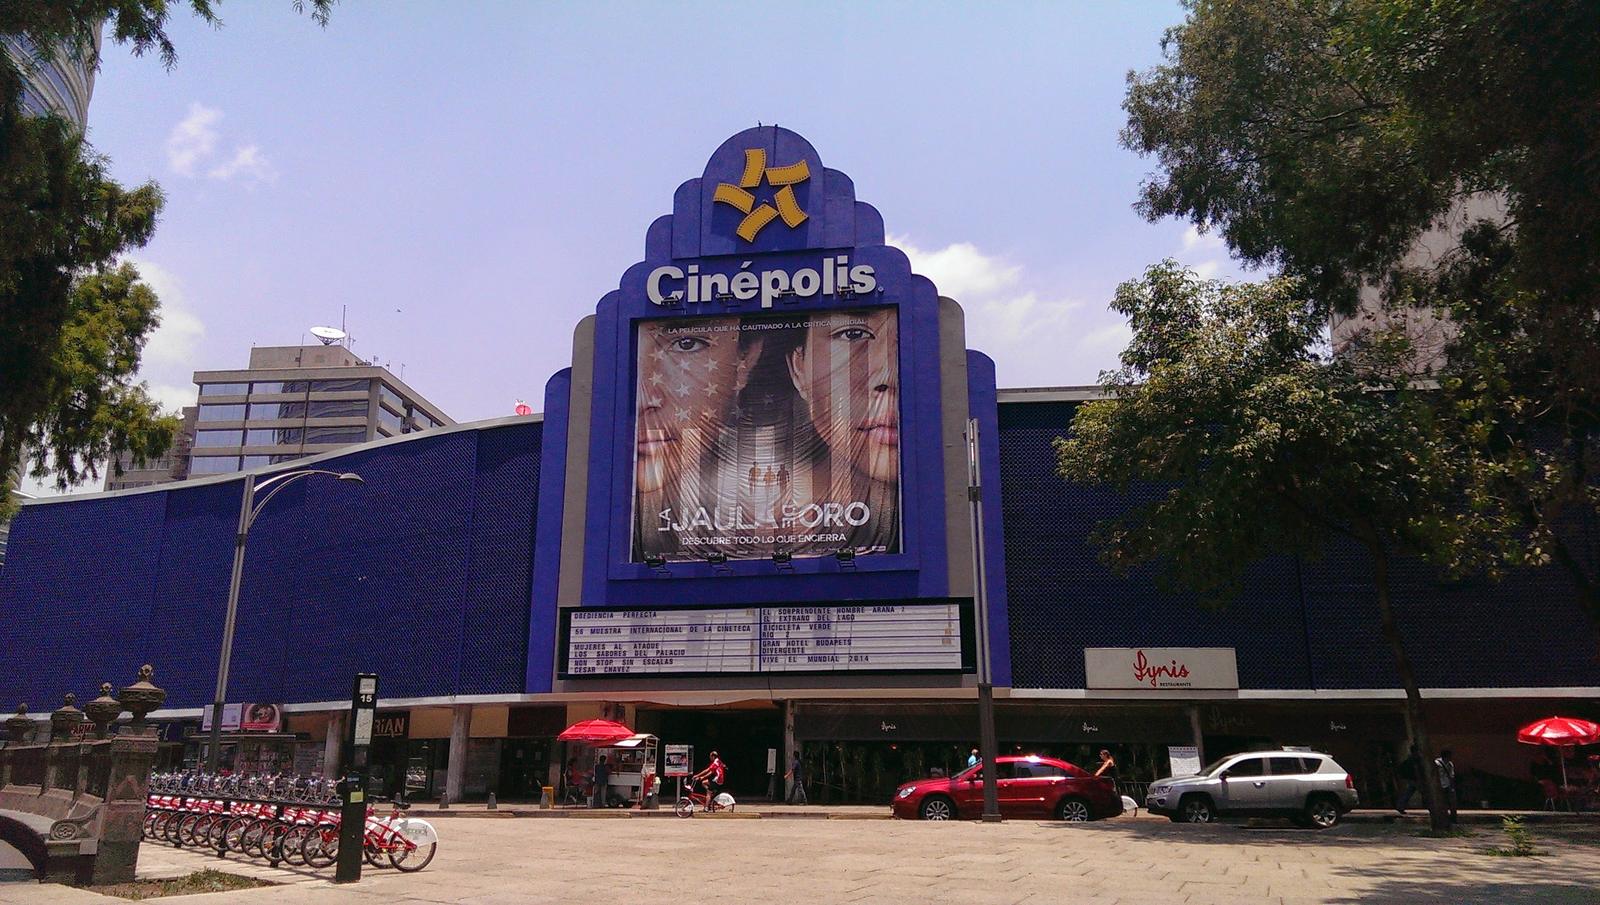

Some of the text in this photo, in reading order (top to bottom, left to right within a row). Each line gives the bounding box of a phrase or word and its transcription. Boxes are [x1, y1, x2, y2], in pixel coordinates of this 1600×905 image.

[646, 255, 876, 309] Cinépolis
[741, 323, 783, 331] CAUTIVADO
[658, 508, 671, 531] LA
[799, 501, 870, 528] ORO
[682, 532, 846, 545] DESCUBRE TODO LO QUE ENCIERRA
[630, 626, 682, 634] INTERNACIONAL
[574, 650, 587, 658] LOS
[360, 694, 373, 703] 15
